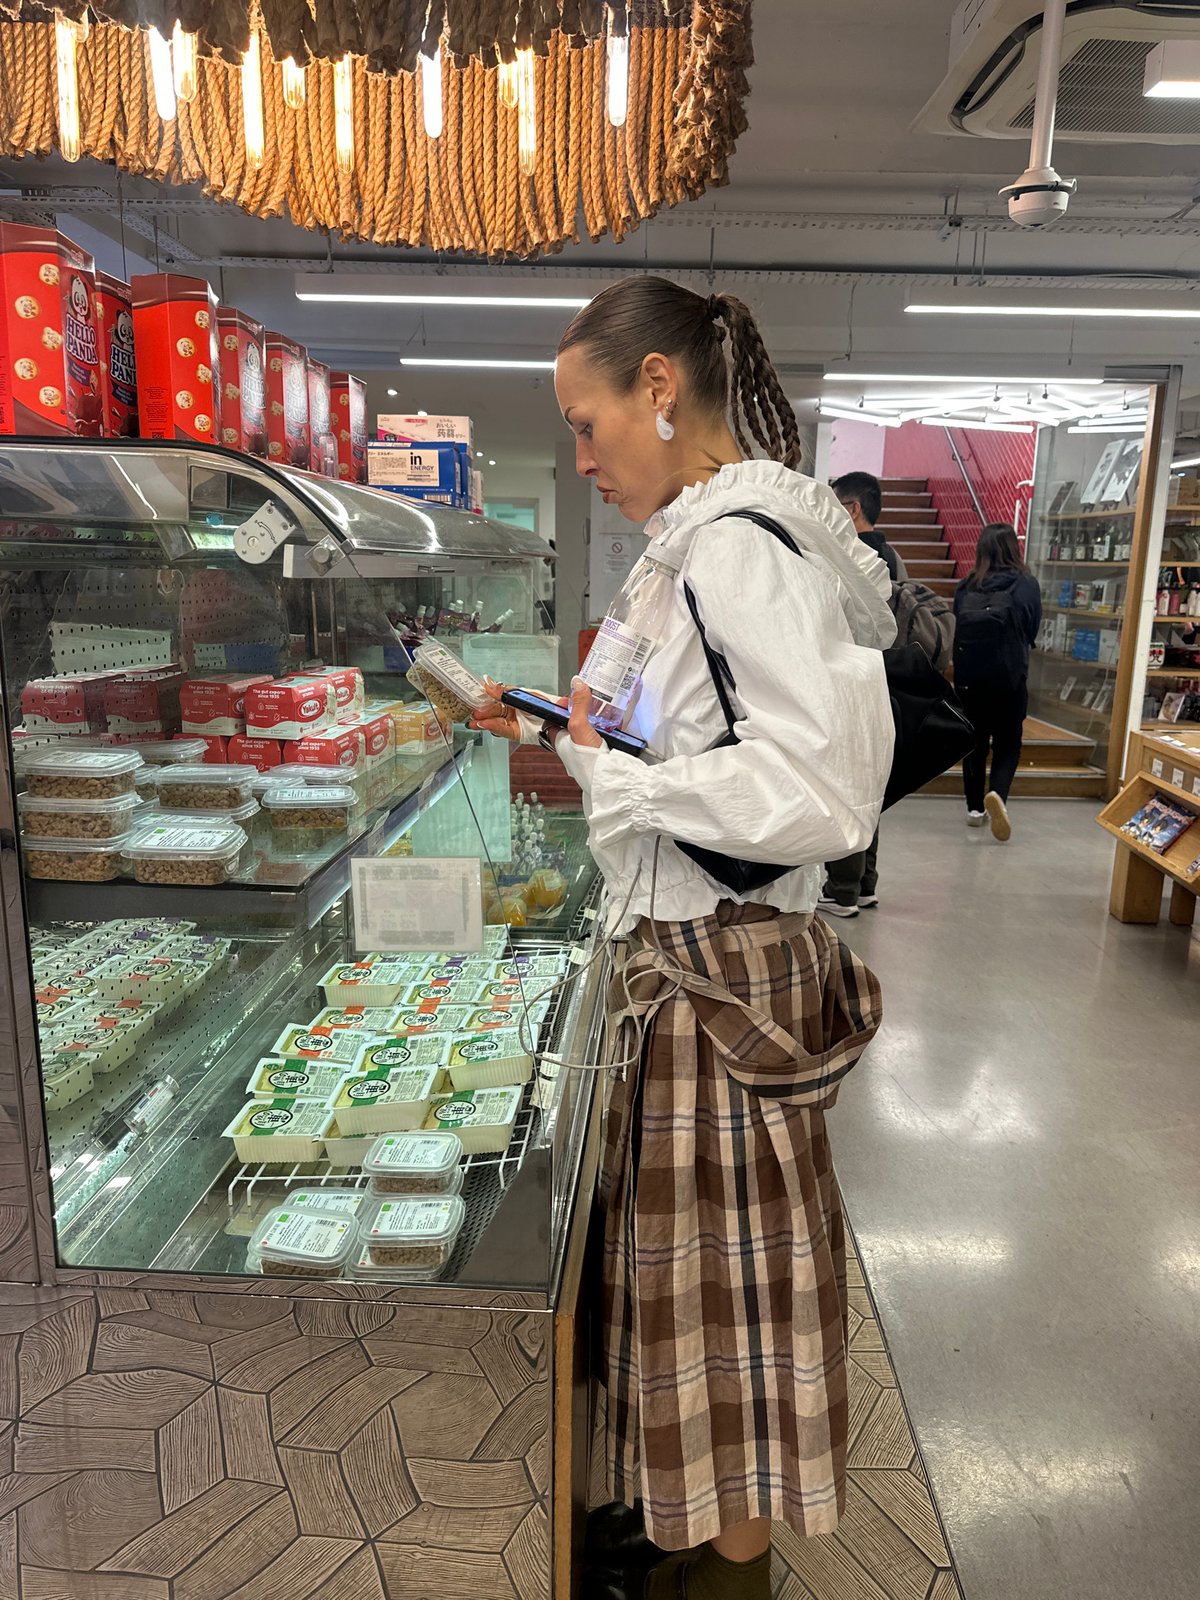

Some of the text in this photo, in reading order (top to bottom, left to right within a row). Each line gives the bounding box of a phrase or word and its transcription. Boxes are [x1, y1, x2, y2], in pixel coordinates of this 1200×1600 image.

[66, 314, 96, 346] HELLO
[66, 335, 98, 364] PANDA
[410, 452, 422, 465] in
[604, 619, 620, 632] BOOST
[303, 702, 319, 714] Yakult
